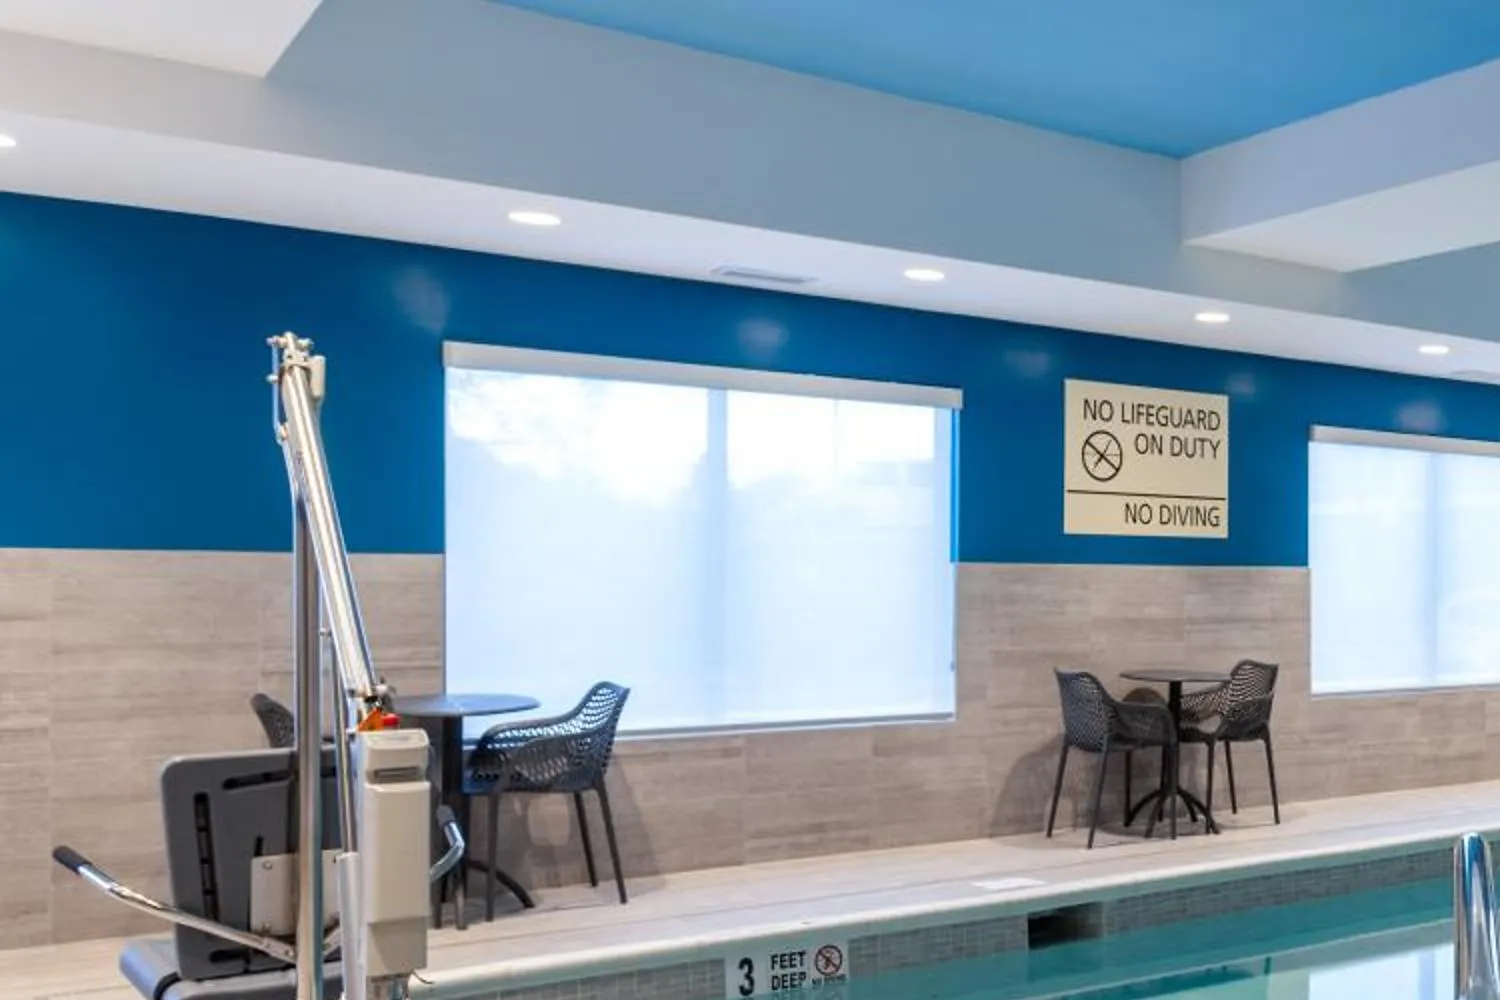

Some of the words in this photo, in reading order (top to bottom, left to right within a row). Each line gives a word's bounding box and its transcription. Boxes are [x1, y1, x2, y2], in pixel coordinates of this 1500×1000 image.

[1083, 399, 1114, 422] NO
[1121, 402, 1221, 431] LIFEGUARD
[1134, 433, 1163, 456] ON
[1170, 436, 1221, 460] DUTY
[1125, 503, 1153, 525] NO
[1159, 504, 1221, 528] DIVING
[770, 951, 807, 971] FEET
[738, 957, 755, 997] 3
[771, 972, 807, 991] DEEP
